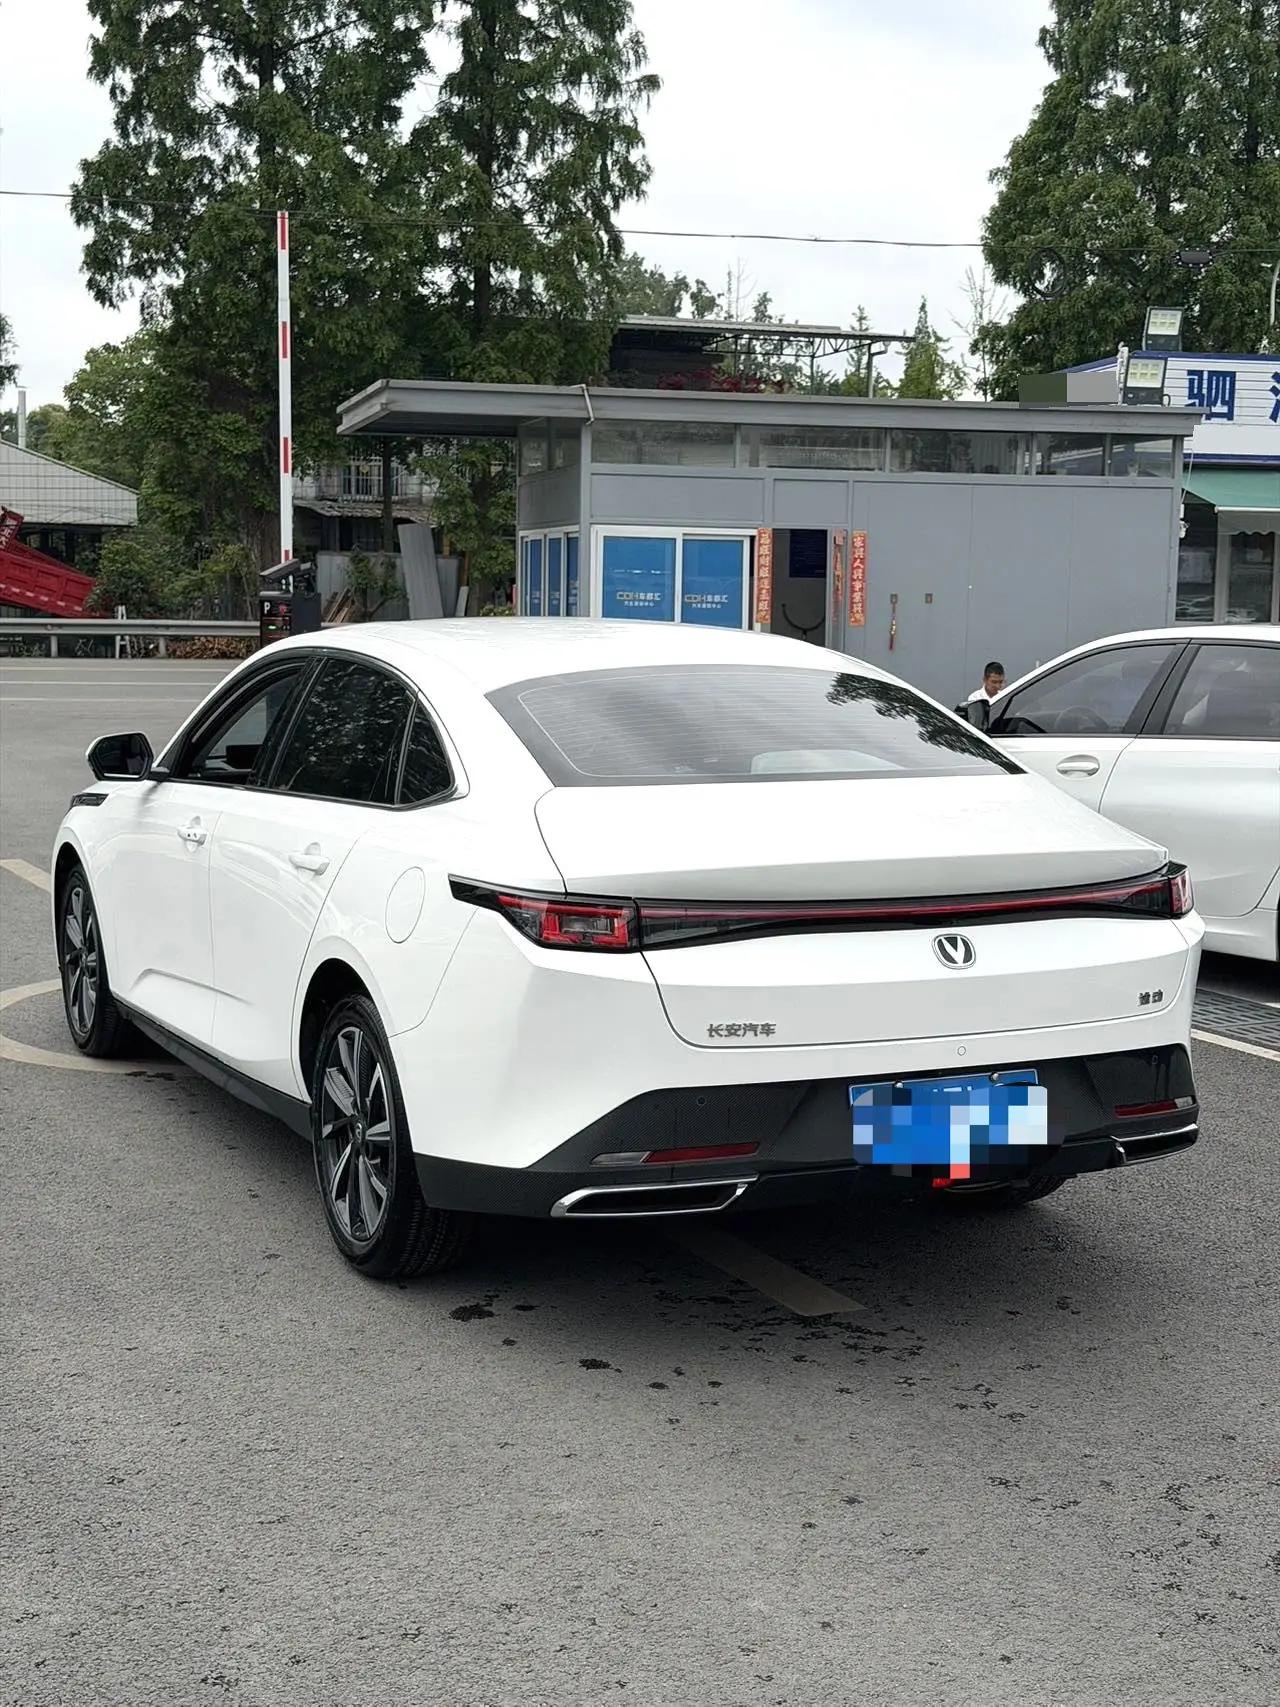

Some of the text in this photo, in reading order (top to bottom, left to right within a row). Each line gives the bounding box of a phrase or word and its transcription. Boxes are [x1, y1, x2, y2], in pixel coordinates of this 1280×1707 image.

[1184, 369, 1280, 423] 驷
[264, 601, 271, 614] P
[707, 1022, 777, 1038] 长安汽车
